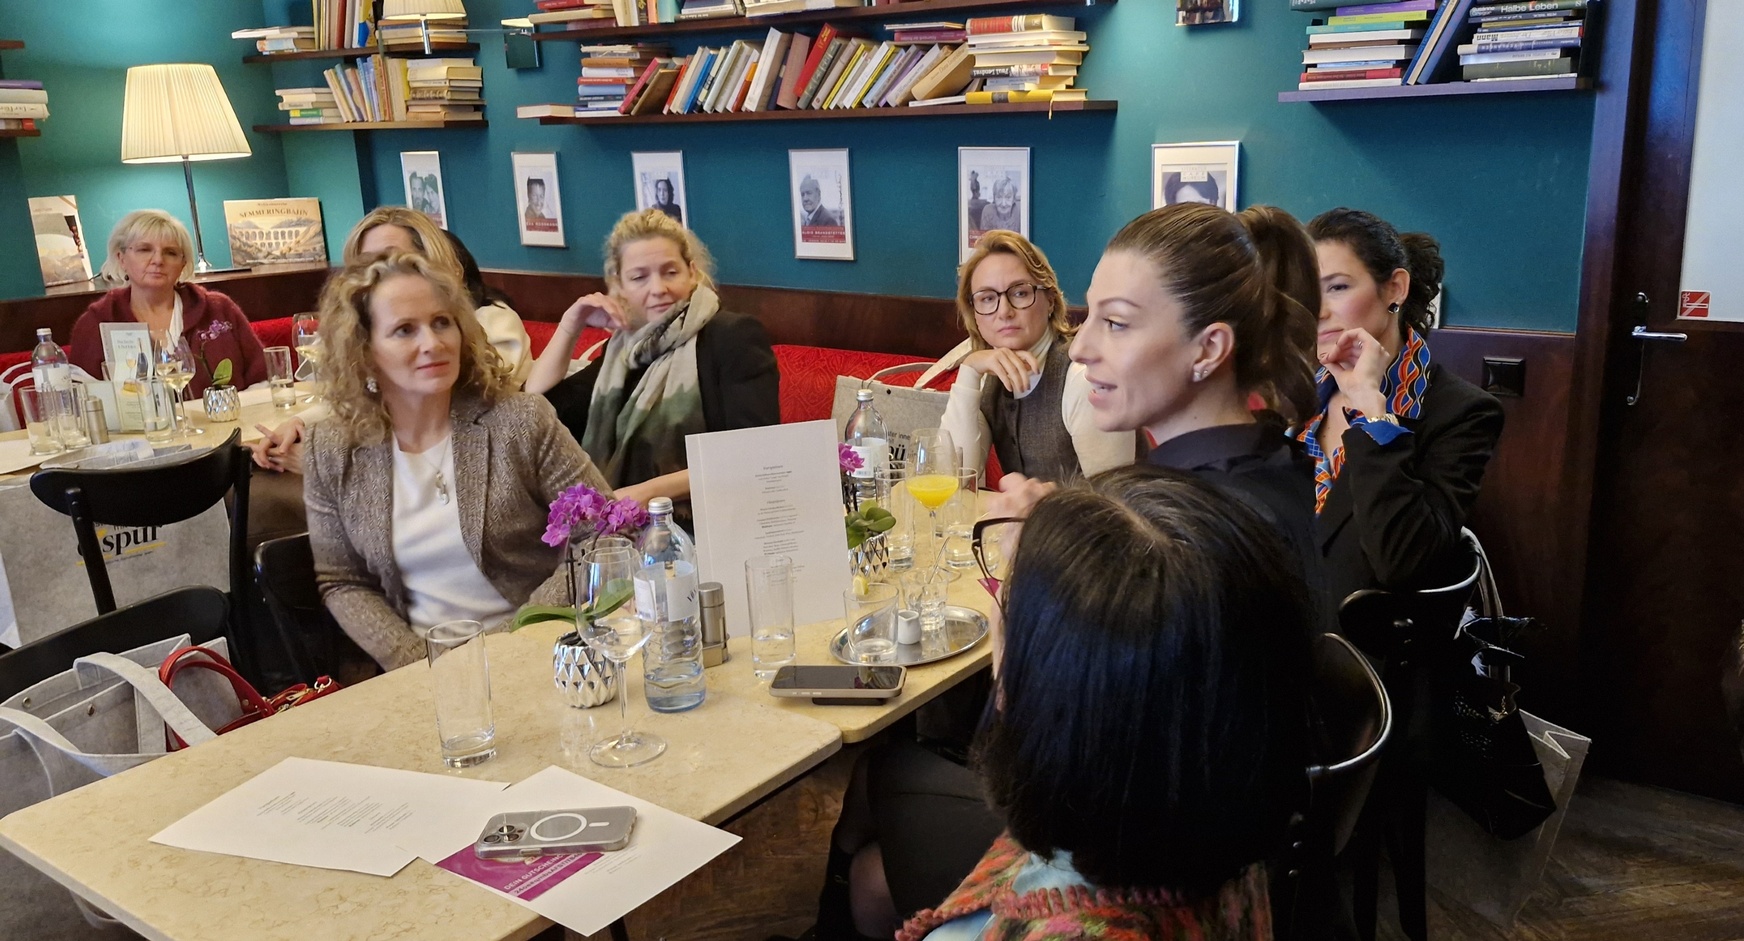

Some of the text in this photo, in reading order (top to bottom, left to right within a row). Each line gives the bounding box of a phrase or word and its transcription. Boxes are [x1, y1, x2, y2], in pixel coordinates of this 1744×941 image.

[1500, 2, 1559, 14] Halbe Leben
[503, 878, 522, 891] DEIN
